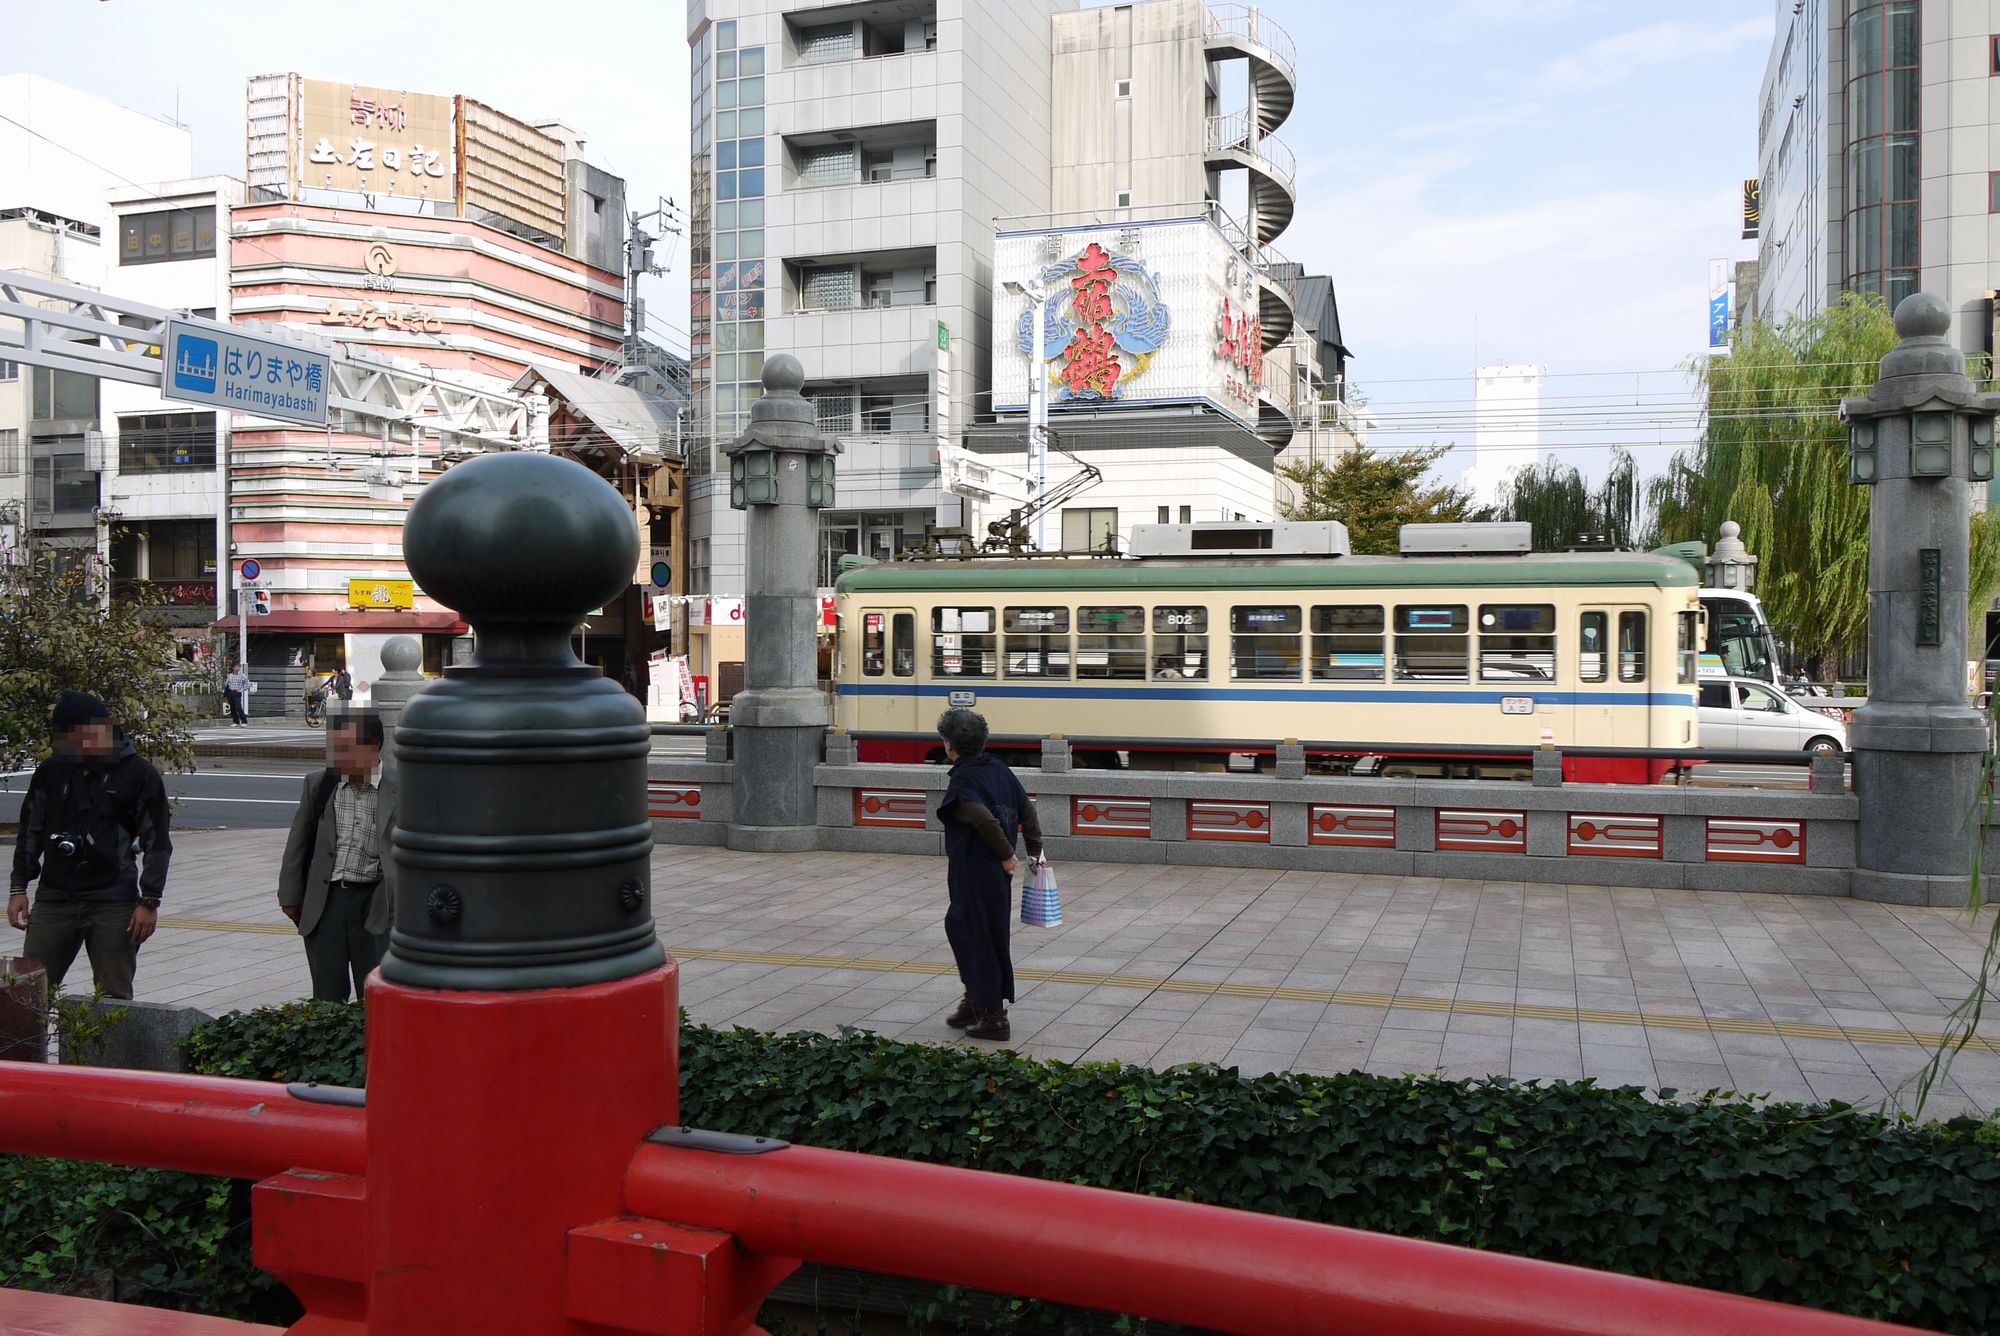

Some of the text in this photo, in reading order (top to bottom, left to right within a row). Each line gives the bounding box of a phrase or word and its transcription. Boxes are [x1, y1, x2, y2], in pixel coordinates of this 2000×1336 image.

[350, 98, 407, 133] 青柳
[309, 136, 445, 178] 土左日記
[1062, 242, 1122, 397] 土佐鶴
[224, 345, 323, 393] はりまや橋
[225, 381, 318, 413] Harimayabashi
[1167, 613, 1193, 625] 802
